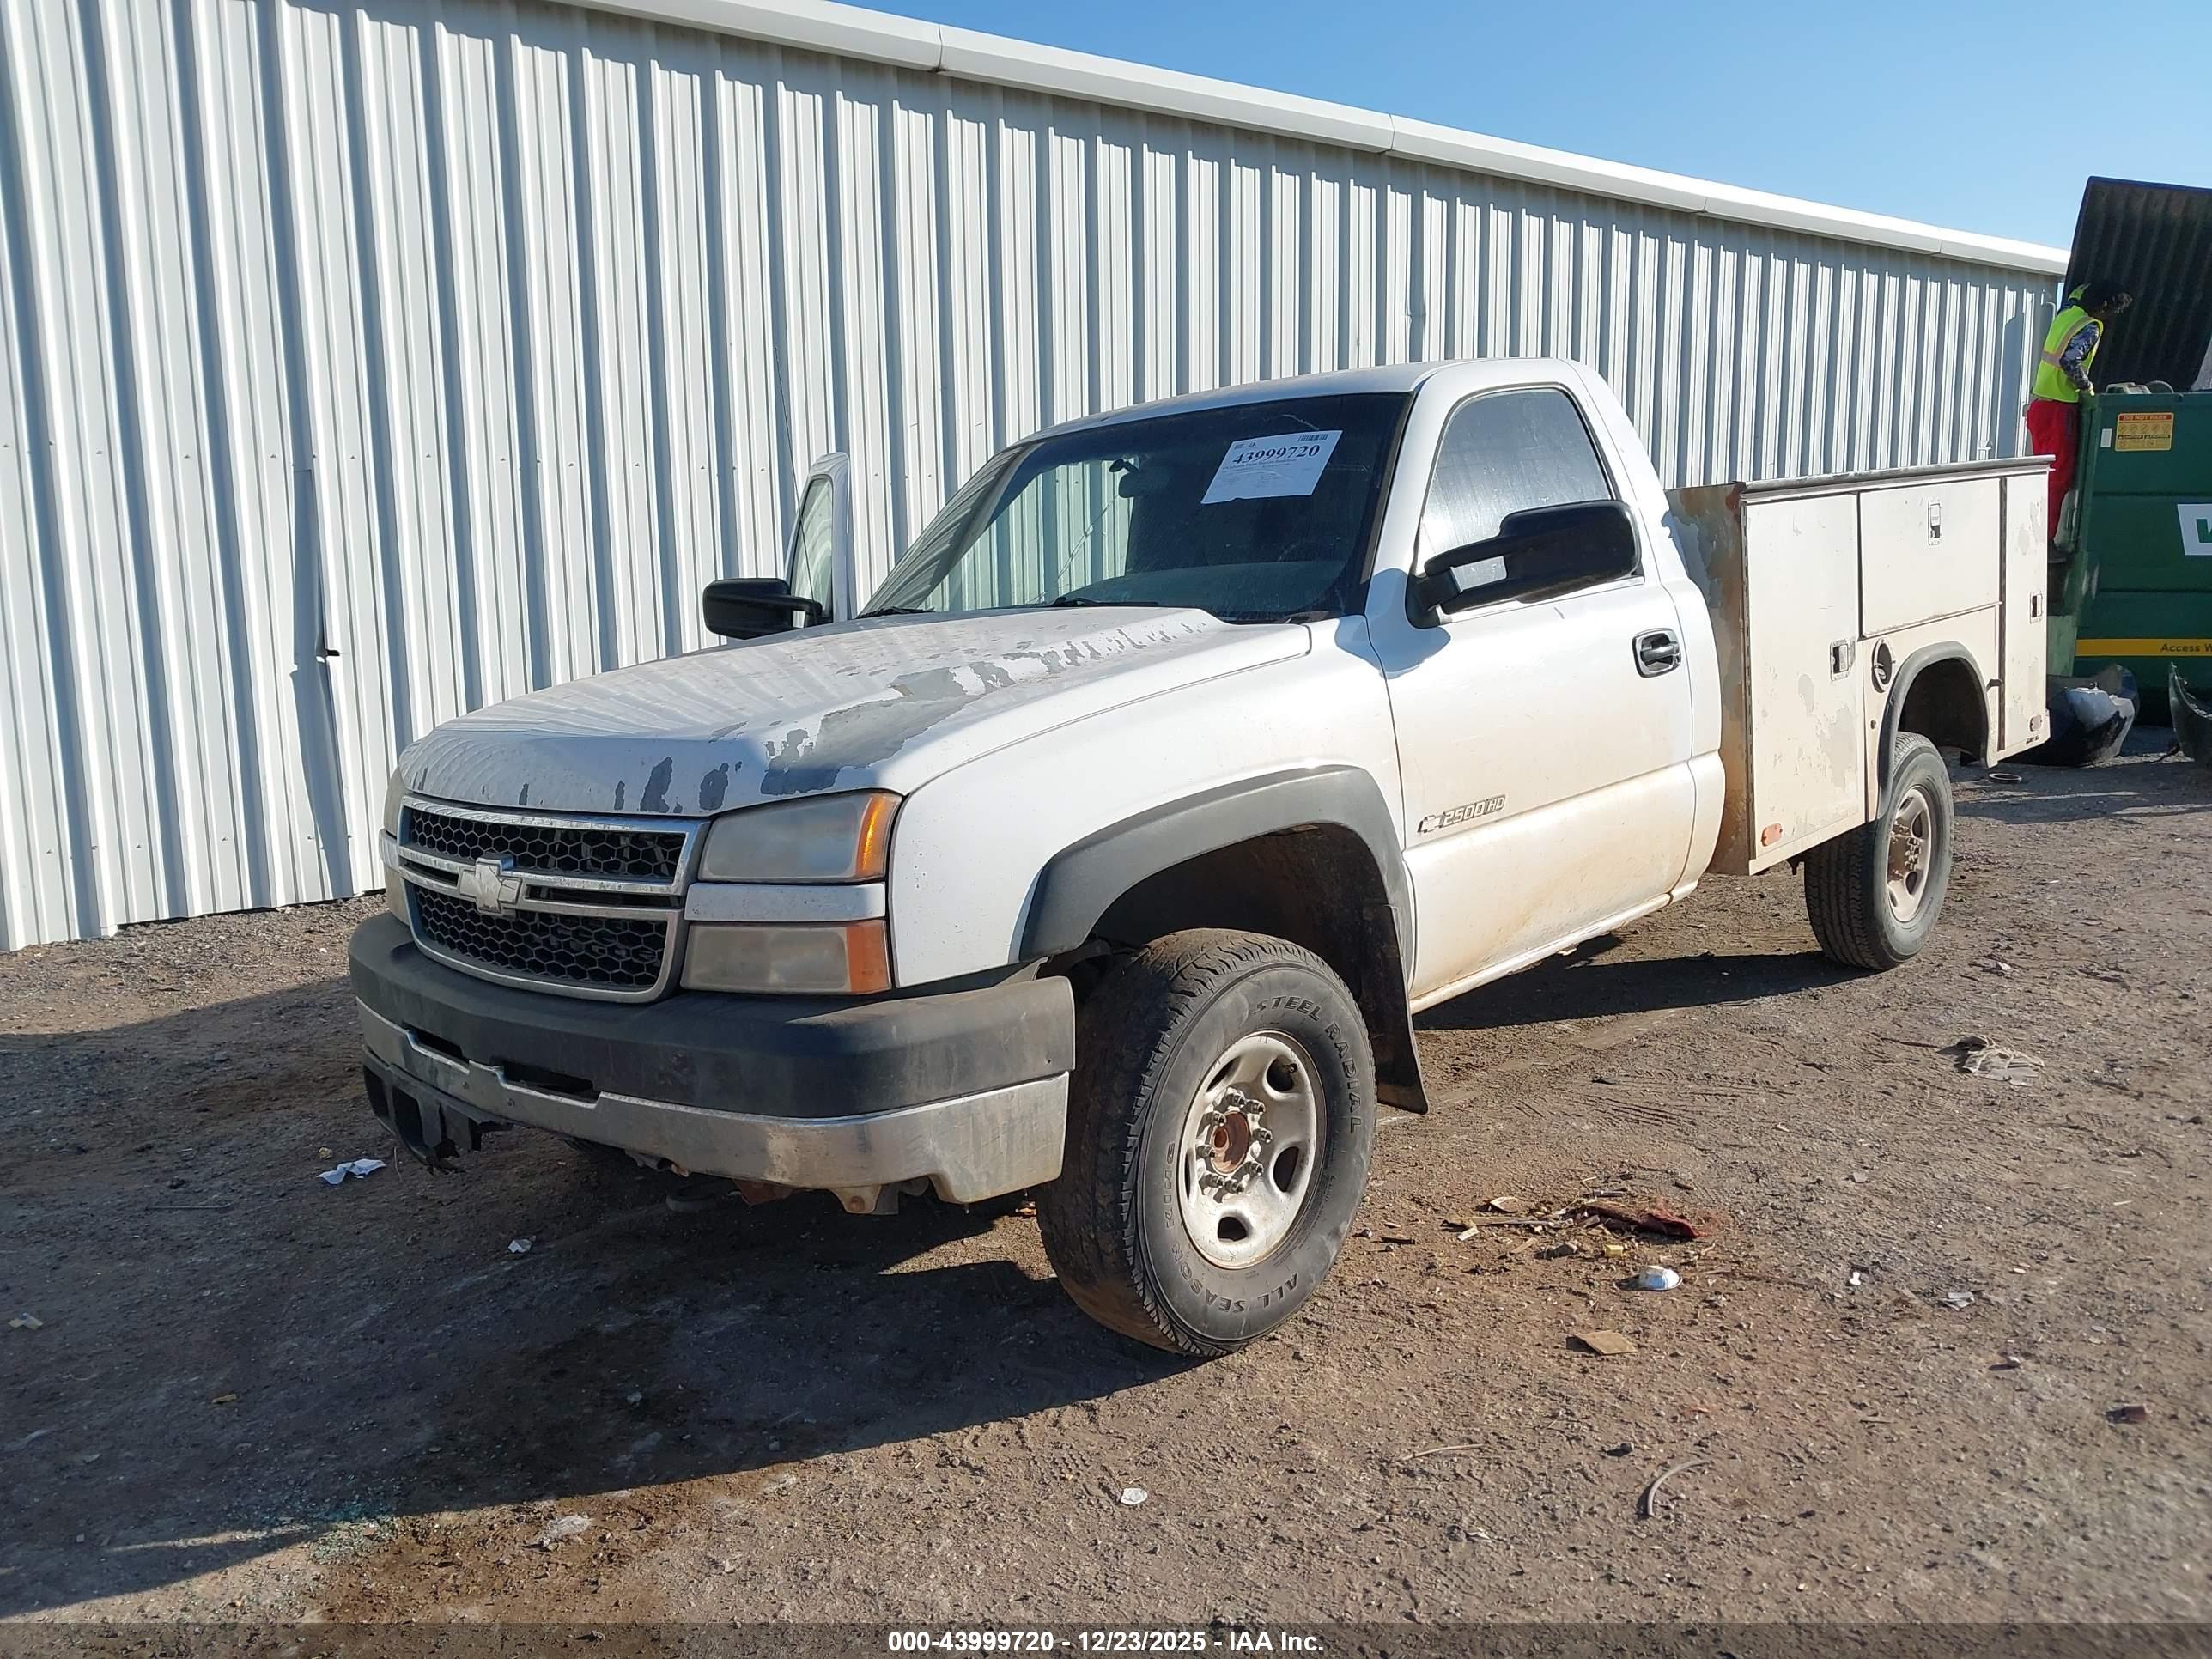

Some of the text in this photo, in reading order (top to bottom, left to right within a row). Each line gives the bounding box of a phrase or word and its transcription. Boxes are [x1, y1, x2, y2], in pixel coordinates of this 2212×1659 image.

[1232, 445, 1321, 464] 43999720
[2160, 643, 2200, 653] Access
[1253, 996, 1361, 1133] STEEL RADIAL
[1164, 1142, 1298, 1312] ALL SEASON KING
